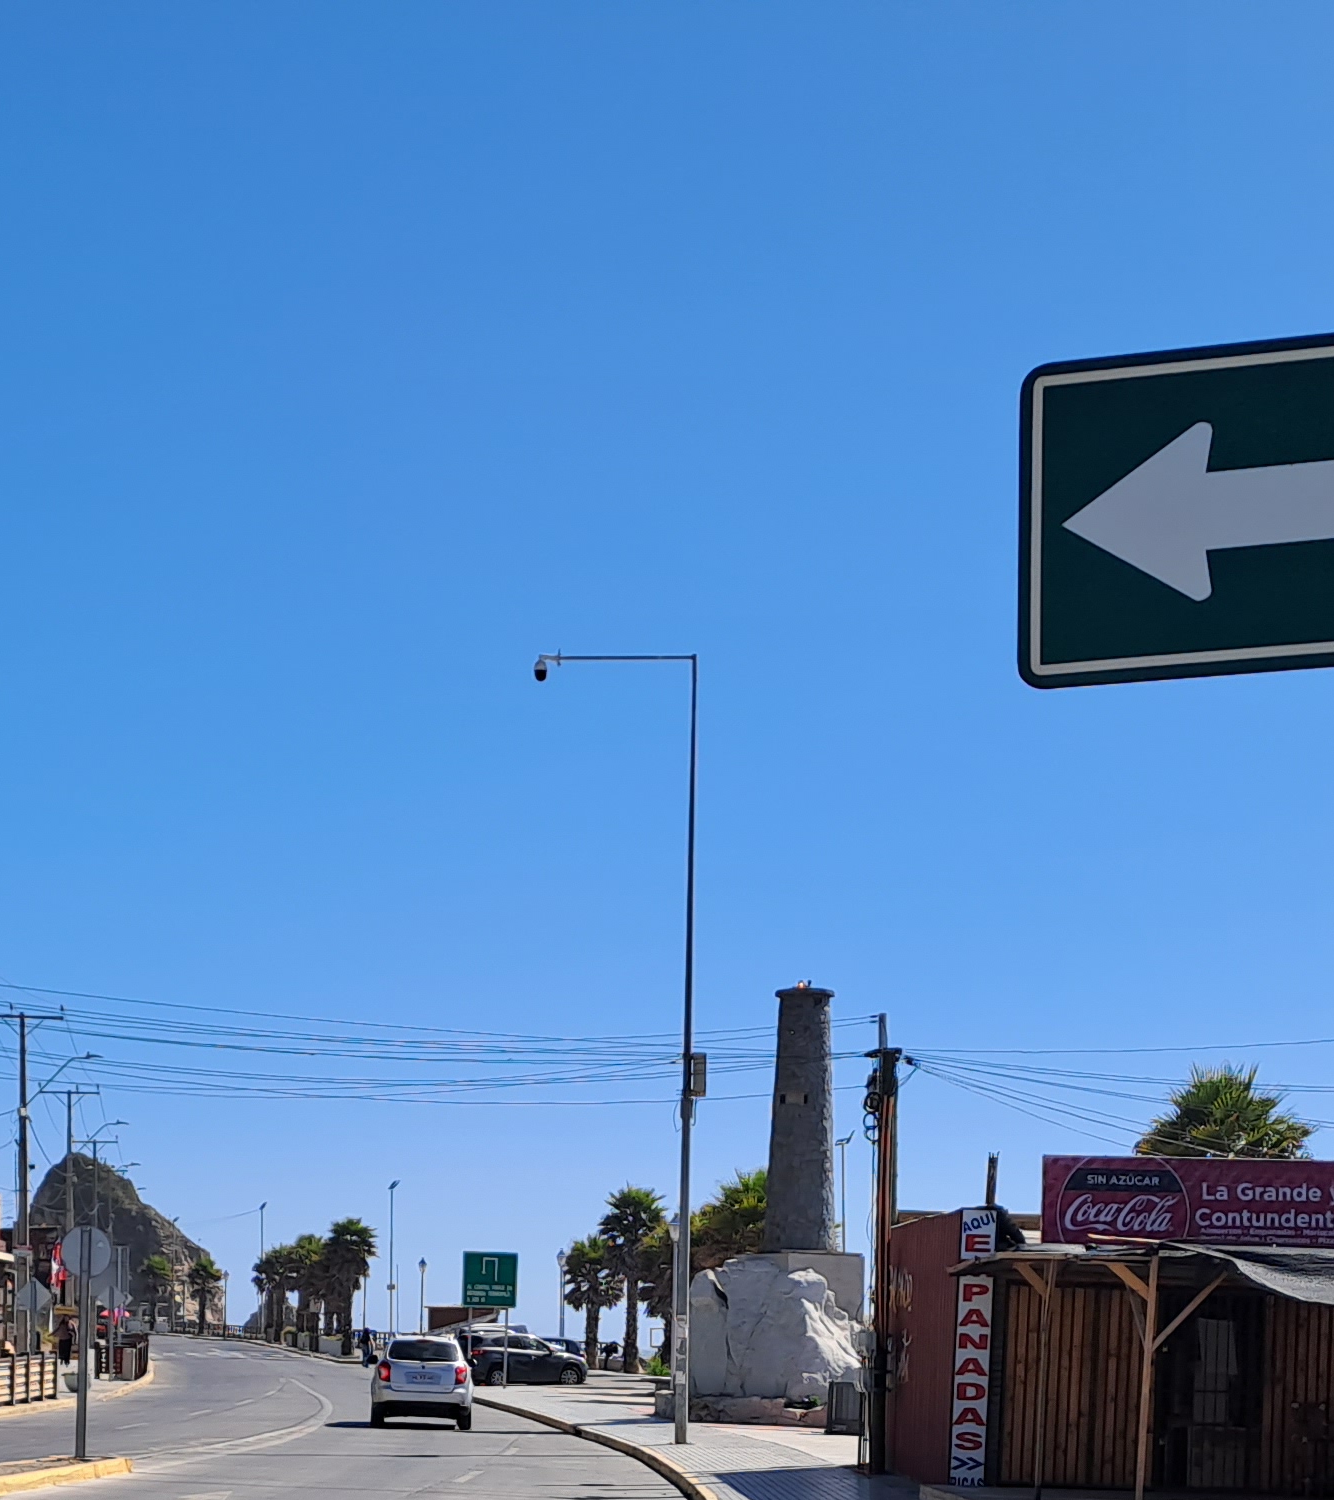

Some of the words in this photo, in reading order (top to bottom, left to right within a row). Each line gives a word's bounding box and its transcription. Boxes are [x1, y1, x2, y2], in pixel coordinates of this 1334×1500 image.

[1086, 1174, 1107, 1185] SIN
[1109, 1173, 1160, 1186] AZÚCAR
[1202, 1181, 1229, 1201] La
[1236, 1182, 1323, 1202] Grande
[954, 1234, 991, 1451] EPANADAS
